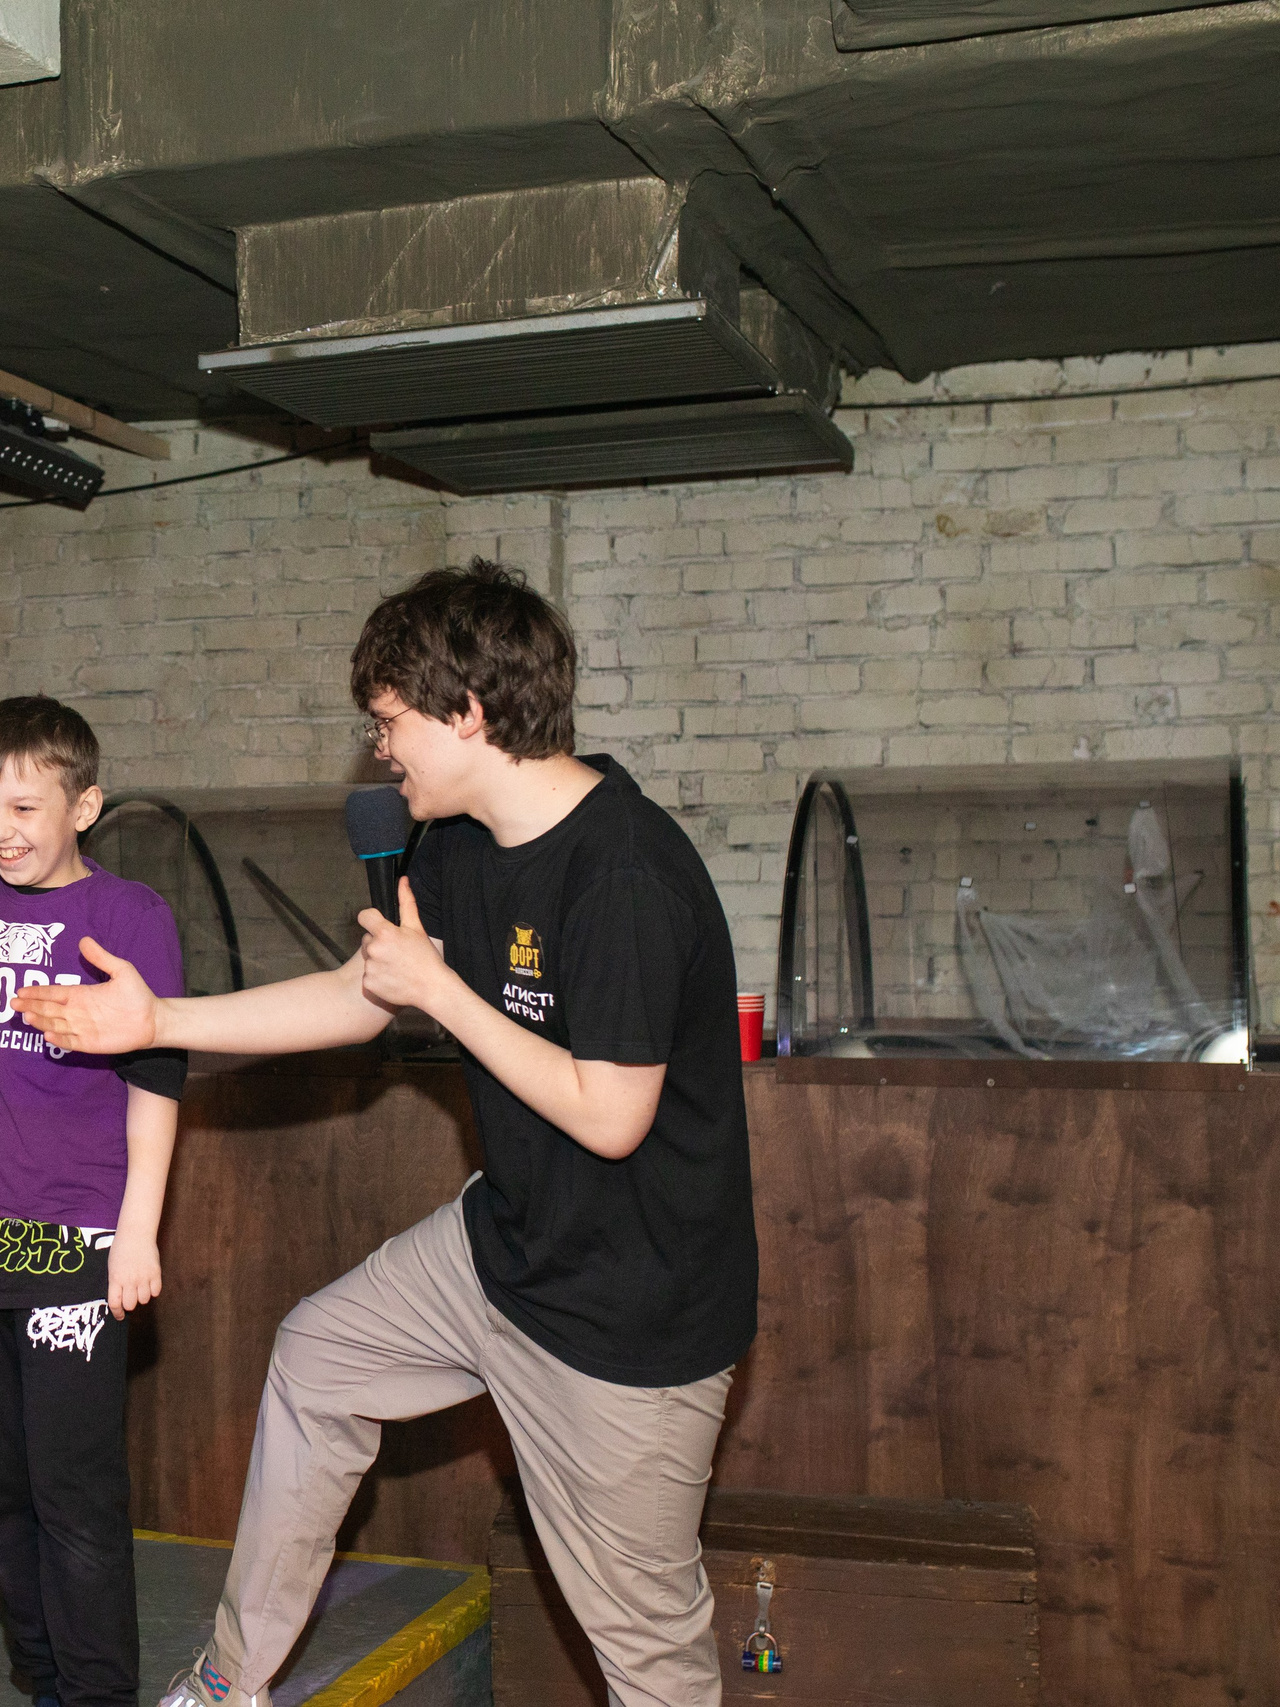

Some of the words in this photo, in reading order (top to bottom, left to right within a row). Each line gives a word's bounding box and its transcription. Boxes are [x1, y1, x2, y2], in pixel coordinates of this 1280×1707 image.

[510, 943, 540, 968] ФОРТ
[504, 998, 545, 1022] ИГРЫ
[26, 1312, 105, 1358] CREW
